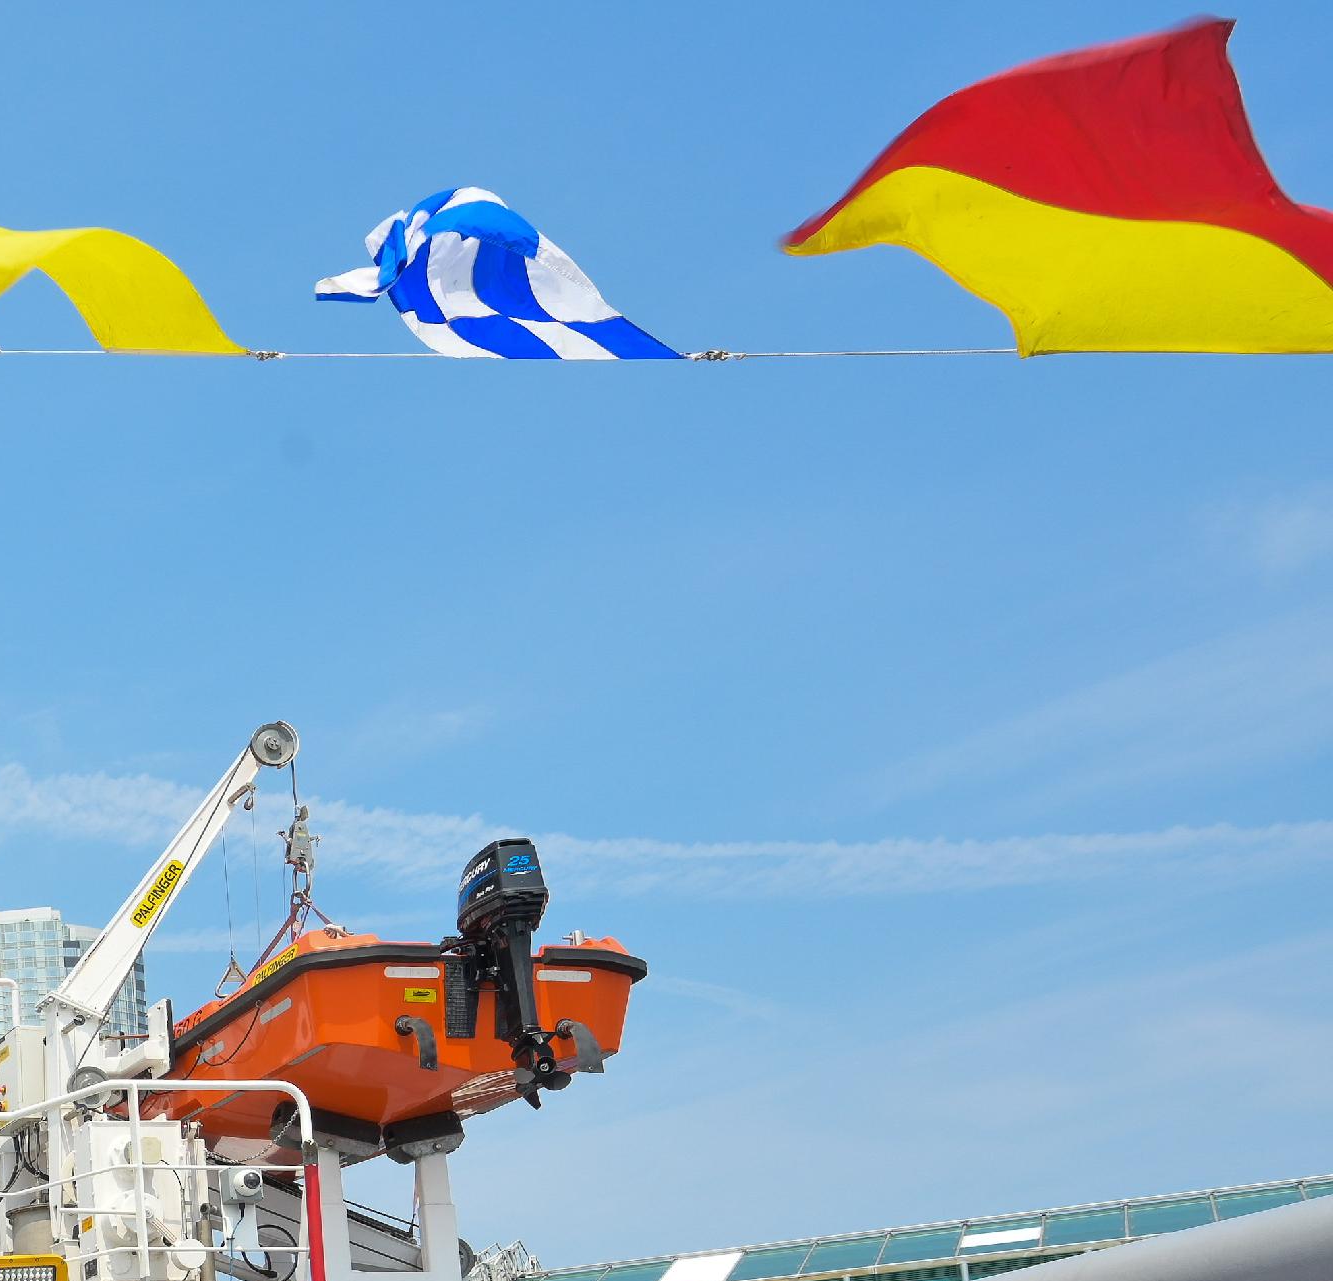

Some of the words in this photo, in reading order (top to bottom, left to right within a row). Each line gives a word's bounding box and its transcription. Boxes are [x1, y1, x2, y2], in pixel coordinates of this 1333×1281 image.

[503, 865, 538, 873] MERCURY
[507, 855, 532, 867] 25
[133, 863, 182, 925] PALFINGER
[254, 948, 296, 985] PALFINGER
